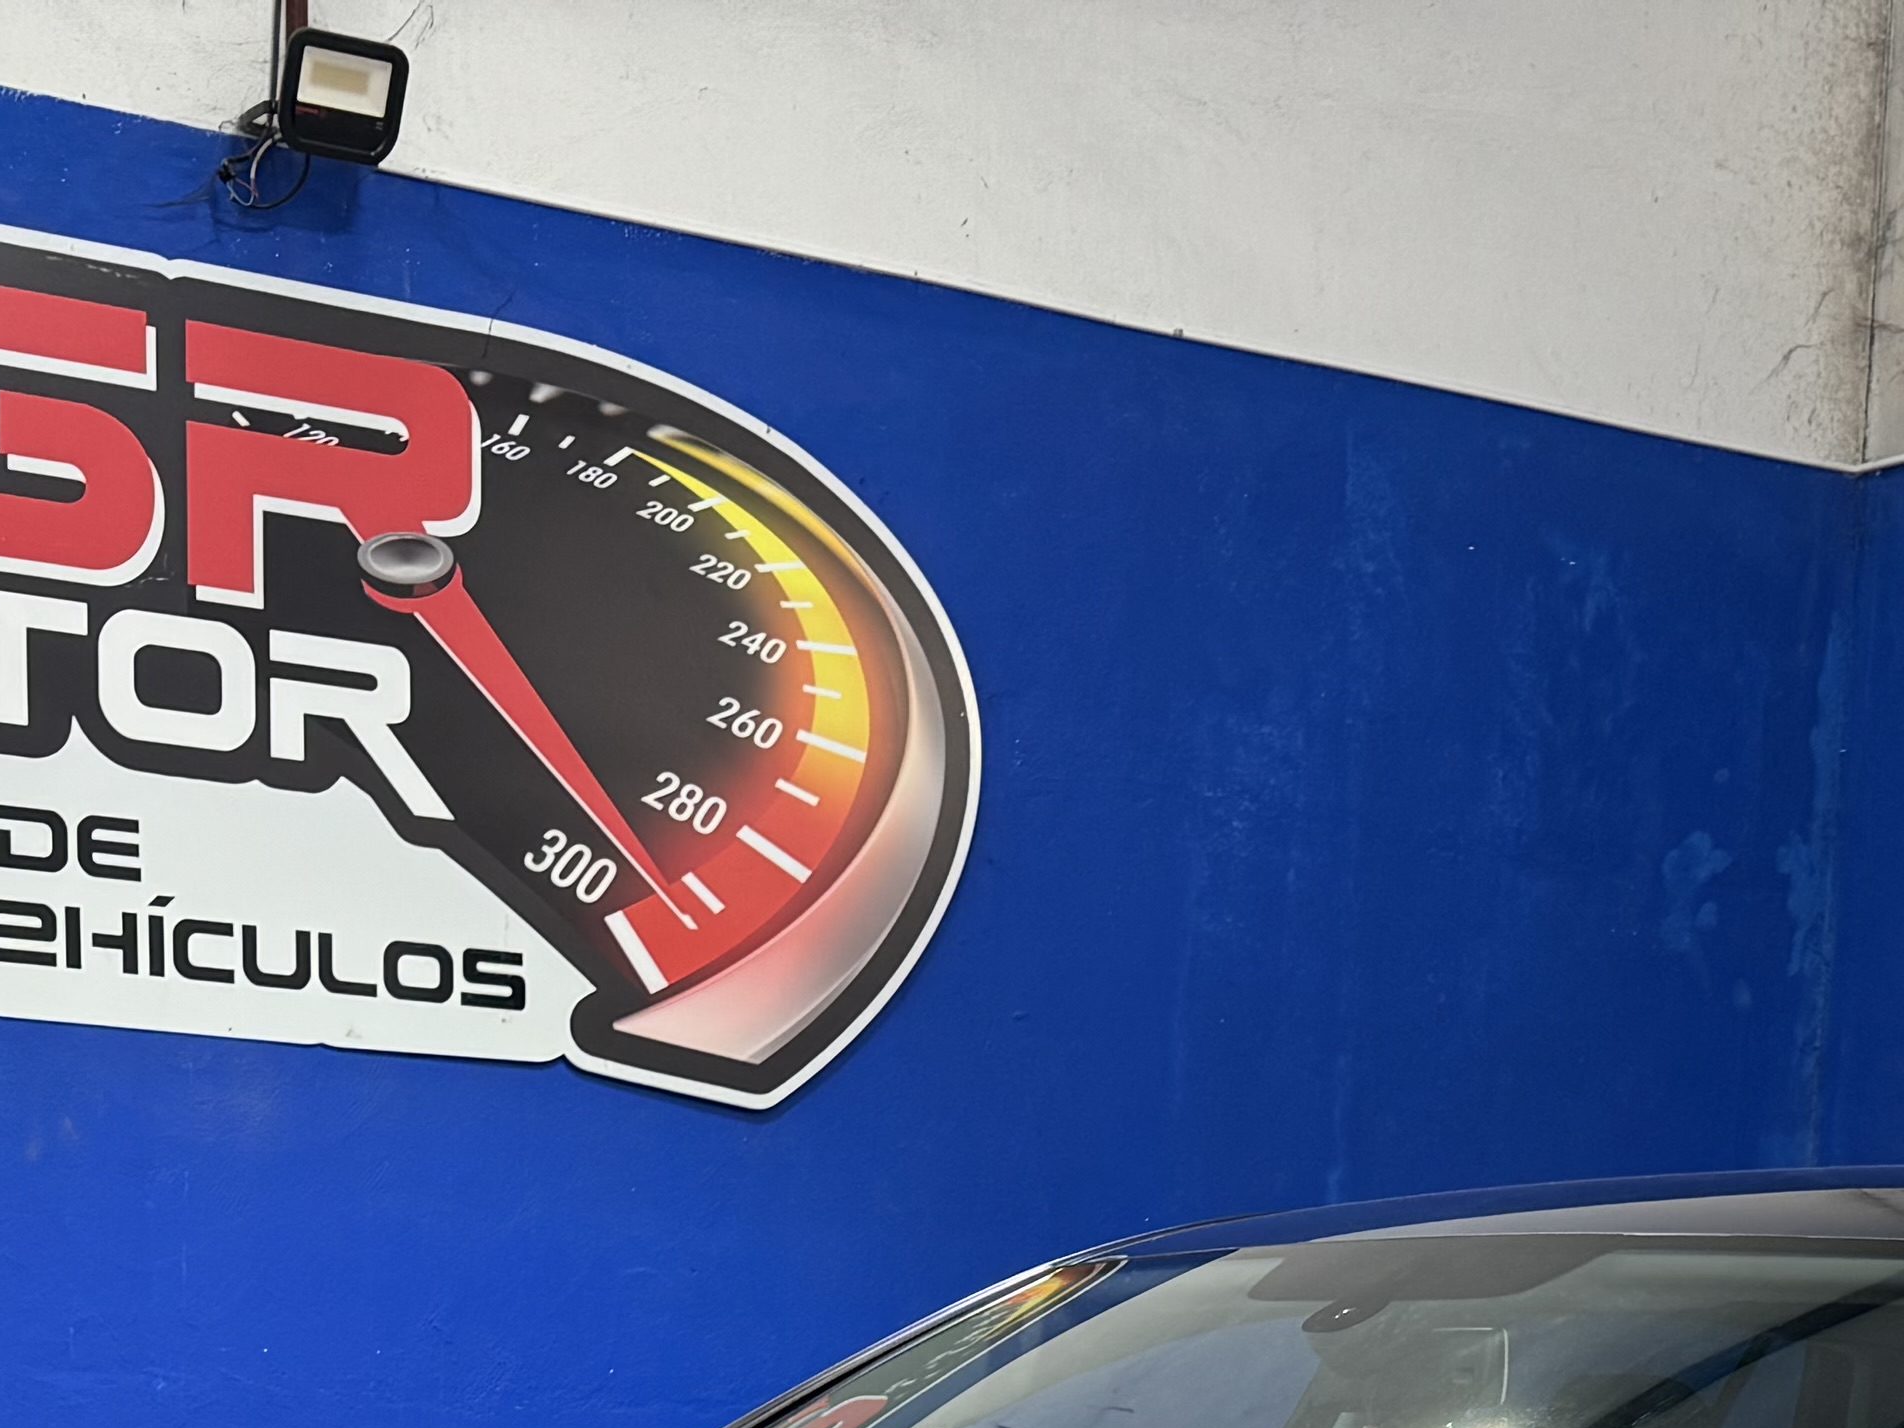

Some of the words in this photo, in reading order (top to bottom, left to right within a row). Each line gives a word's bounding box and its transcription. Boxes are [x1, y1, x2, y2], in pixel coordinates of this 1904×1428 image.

[481, 432, 531, 463] 160
[566, 458, 619, 491] 180
[636, 499, 696, 534] 200
[689, 553, 753, 592] 220
[717, 620, 788, 665] 240
[705, 696, 785, 750] 260
[640, 771, 729, 836] 280
[523, 828, 619, 905] 300
